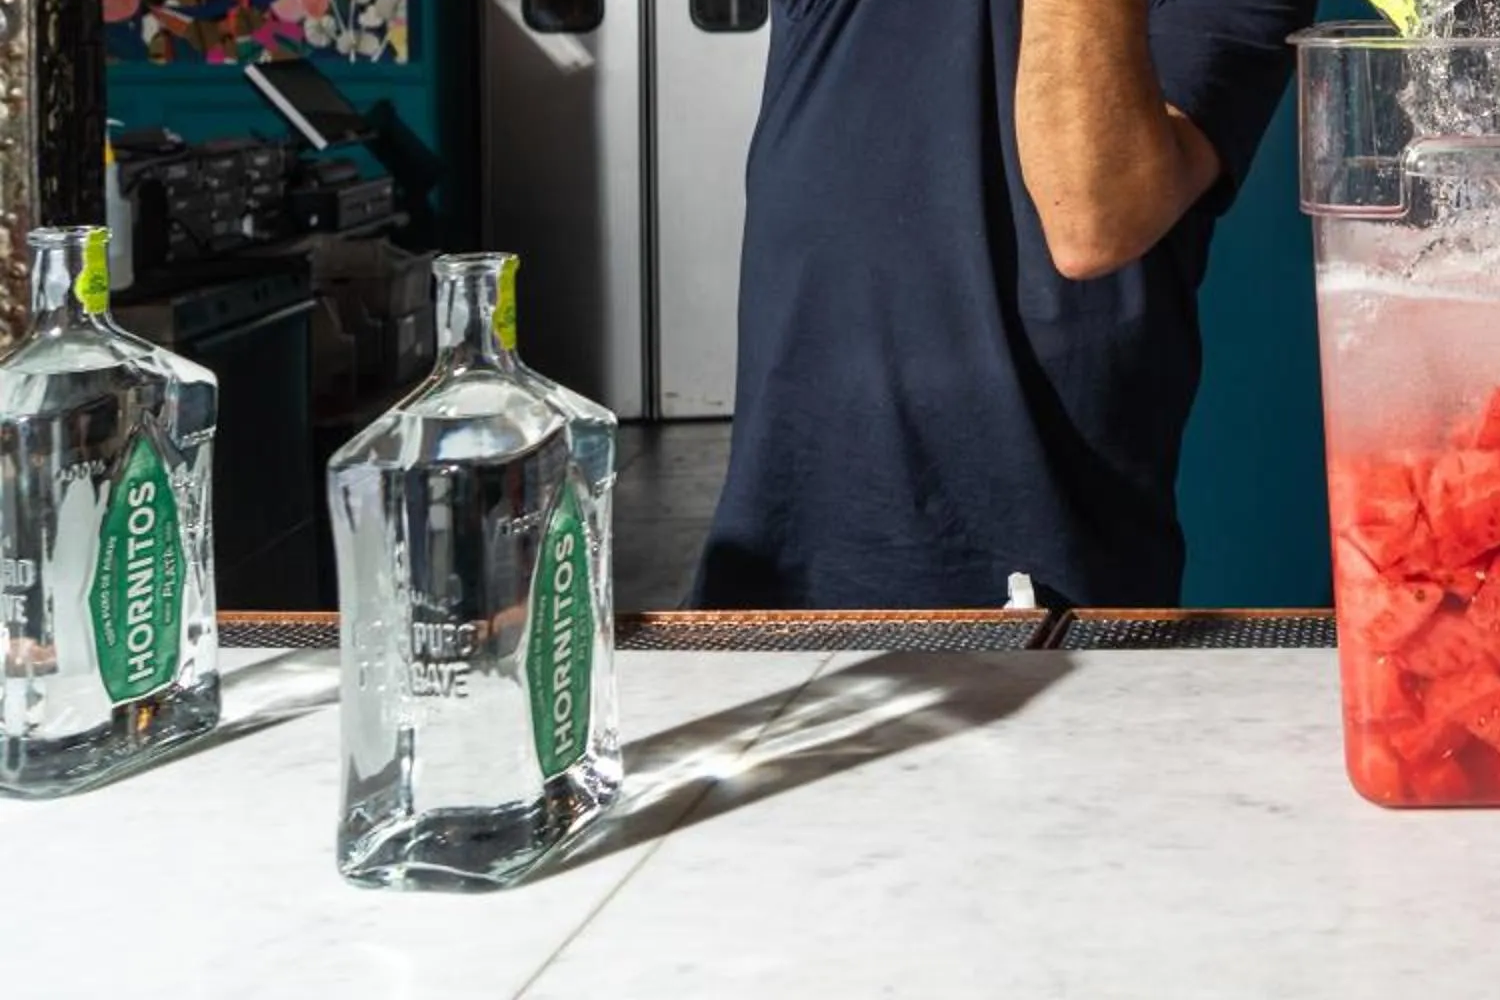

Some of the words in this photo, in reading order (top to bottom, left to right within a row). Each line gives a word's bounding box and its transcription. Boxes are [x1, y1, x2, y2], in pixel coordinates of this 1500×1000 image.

[128, 481, 155, 683] HORNITOS
[162, 544, 176, 597] PLATA
[553, 532, 575, 755] HORNITOS
